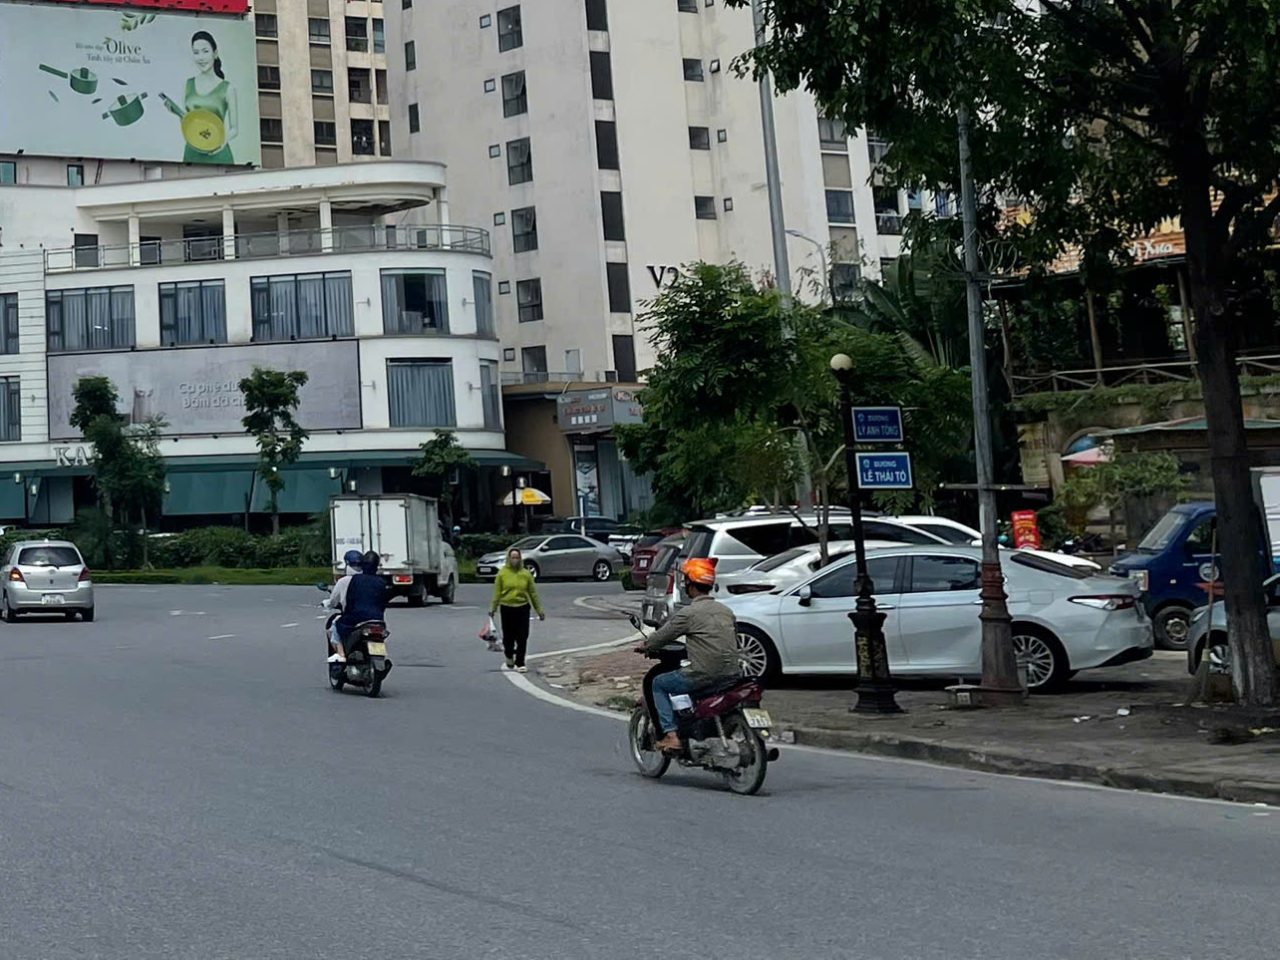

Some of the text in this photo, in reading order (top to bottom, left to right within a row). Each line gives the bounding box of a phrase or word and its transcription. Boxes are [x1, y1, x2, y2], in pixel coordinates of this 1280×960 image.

[106, 39, 141, 55] Olive
[863, 469, 874, 482] LÊ
[875, 468, 894, 482] THÁI
